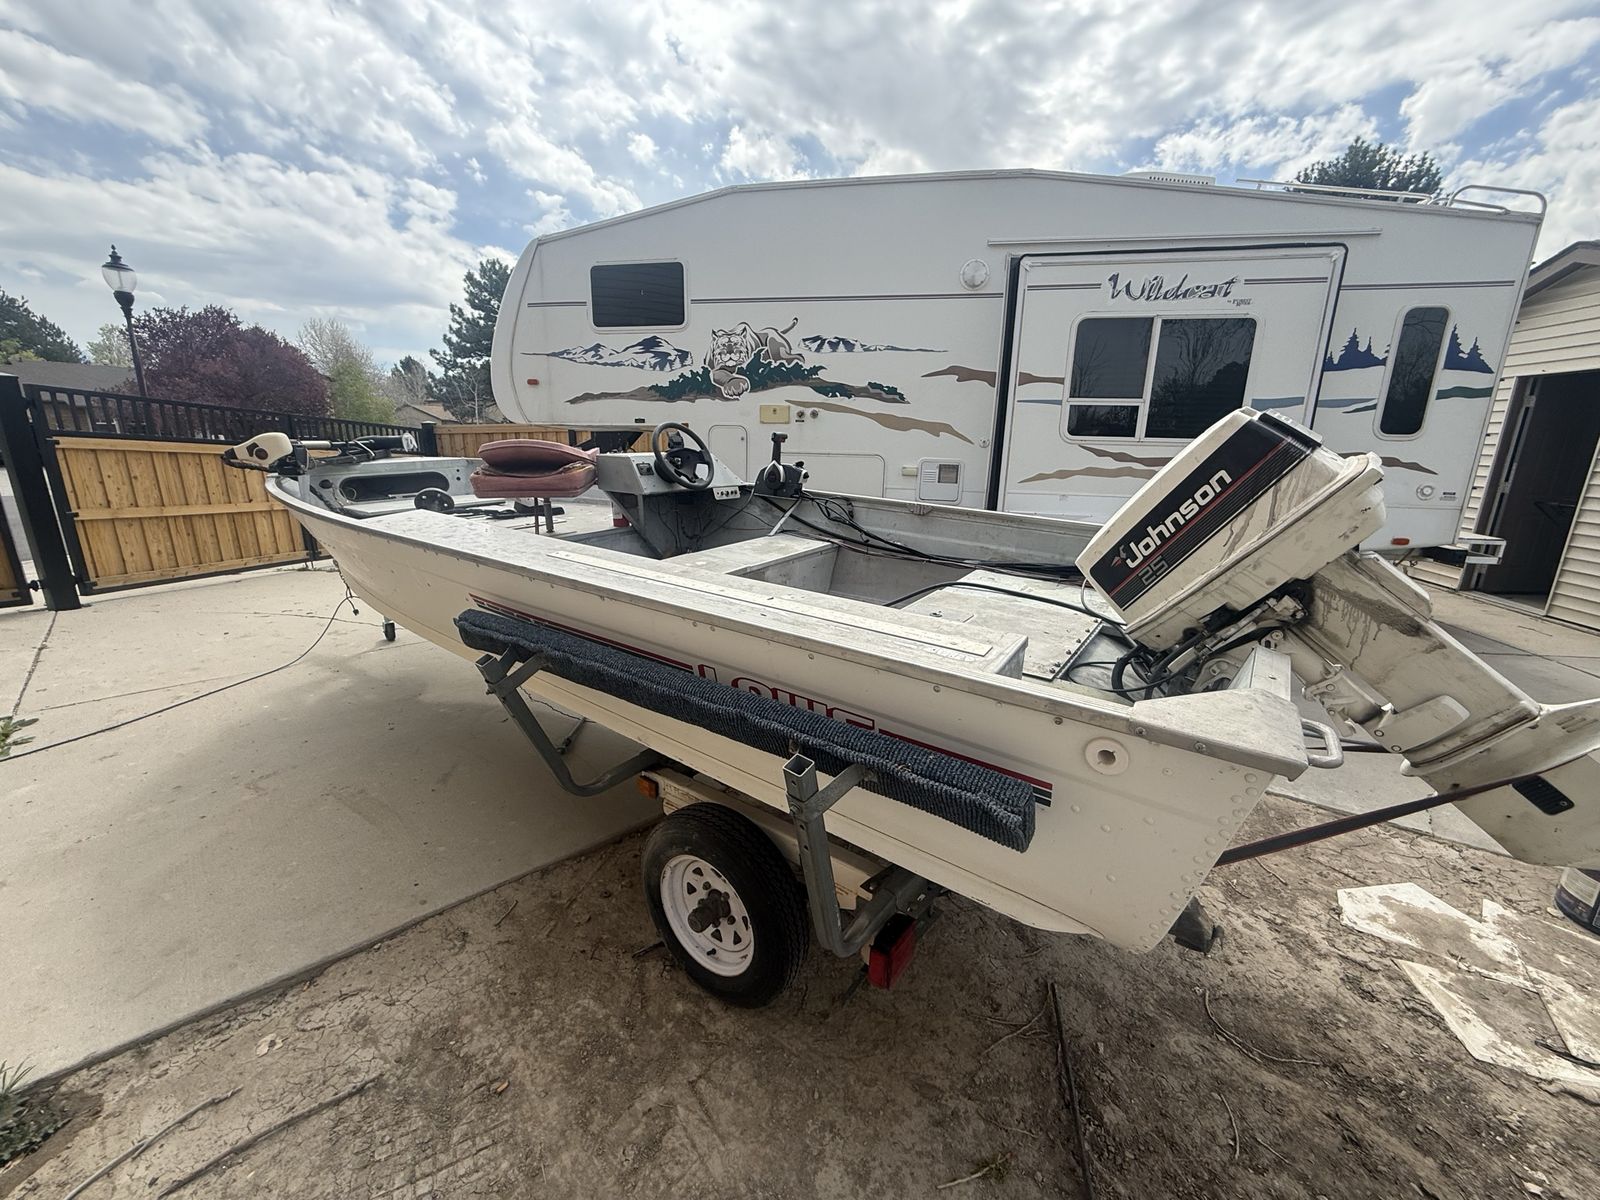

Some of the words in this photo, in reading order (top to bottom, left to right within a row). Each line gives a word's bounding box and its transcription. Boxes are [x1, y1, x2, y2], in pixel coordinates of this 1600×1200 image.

[1107, 272, 1239, 302] Wildcat
[1126, 469, 1232, 568] Johnson
[1137, 556, 1169, 586] 25
